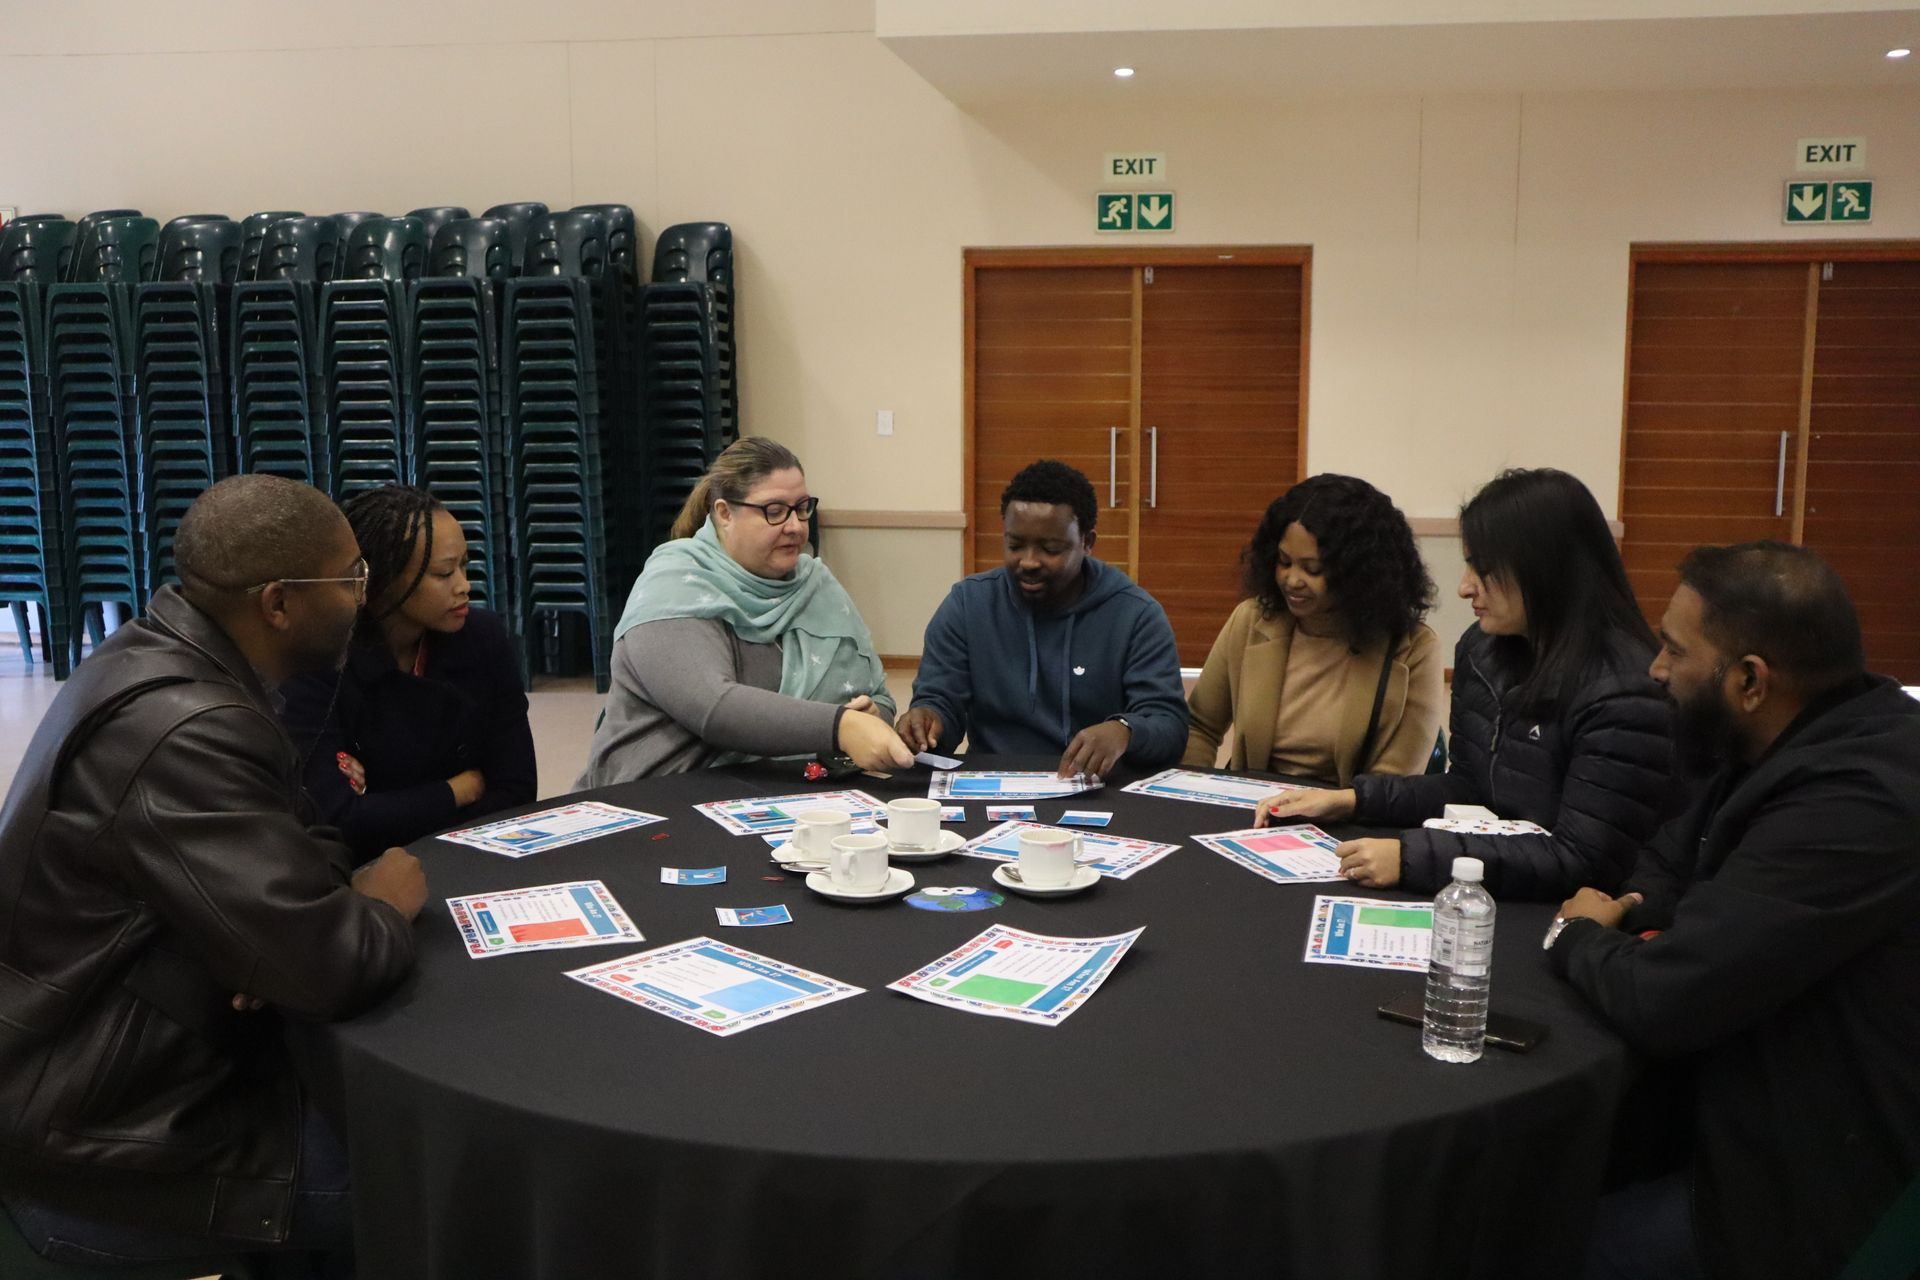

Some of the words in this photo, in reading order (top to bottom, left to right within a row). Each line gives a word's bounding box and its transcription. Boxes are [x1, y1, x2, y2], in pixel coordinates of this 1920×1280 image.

[1806, 144, 1857, 163] EXIT
[1112, 158, 1157, 175] EXIT
[736, 960, 756, 970] Who
[755, 967, 770, 975] Am
